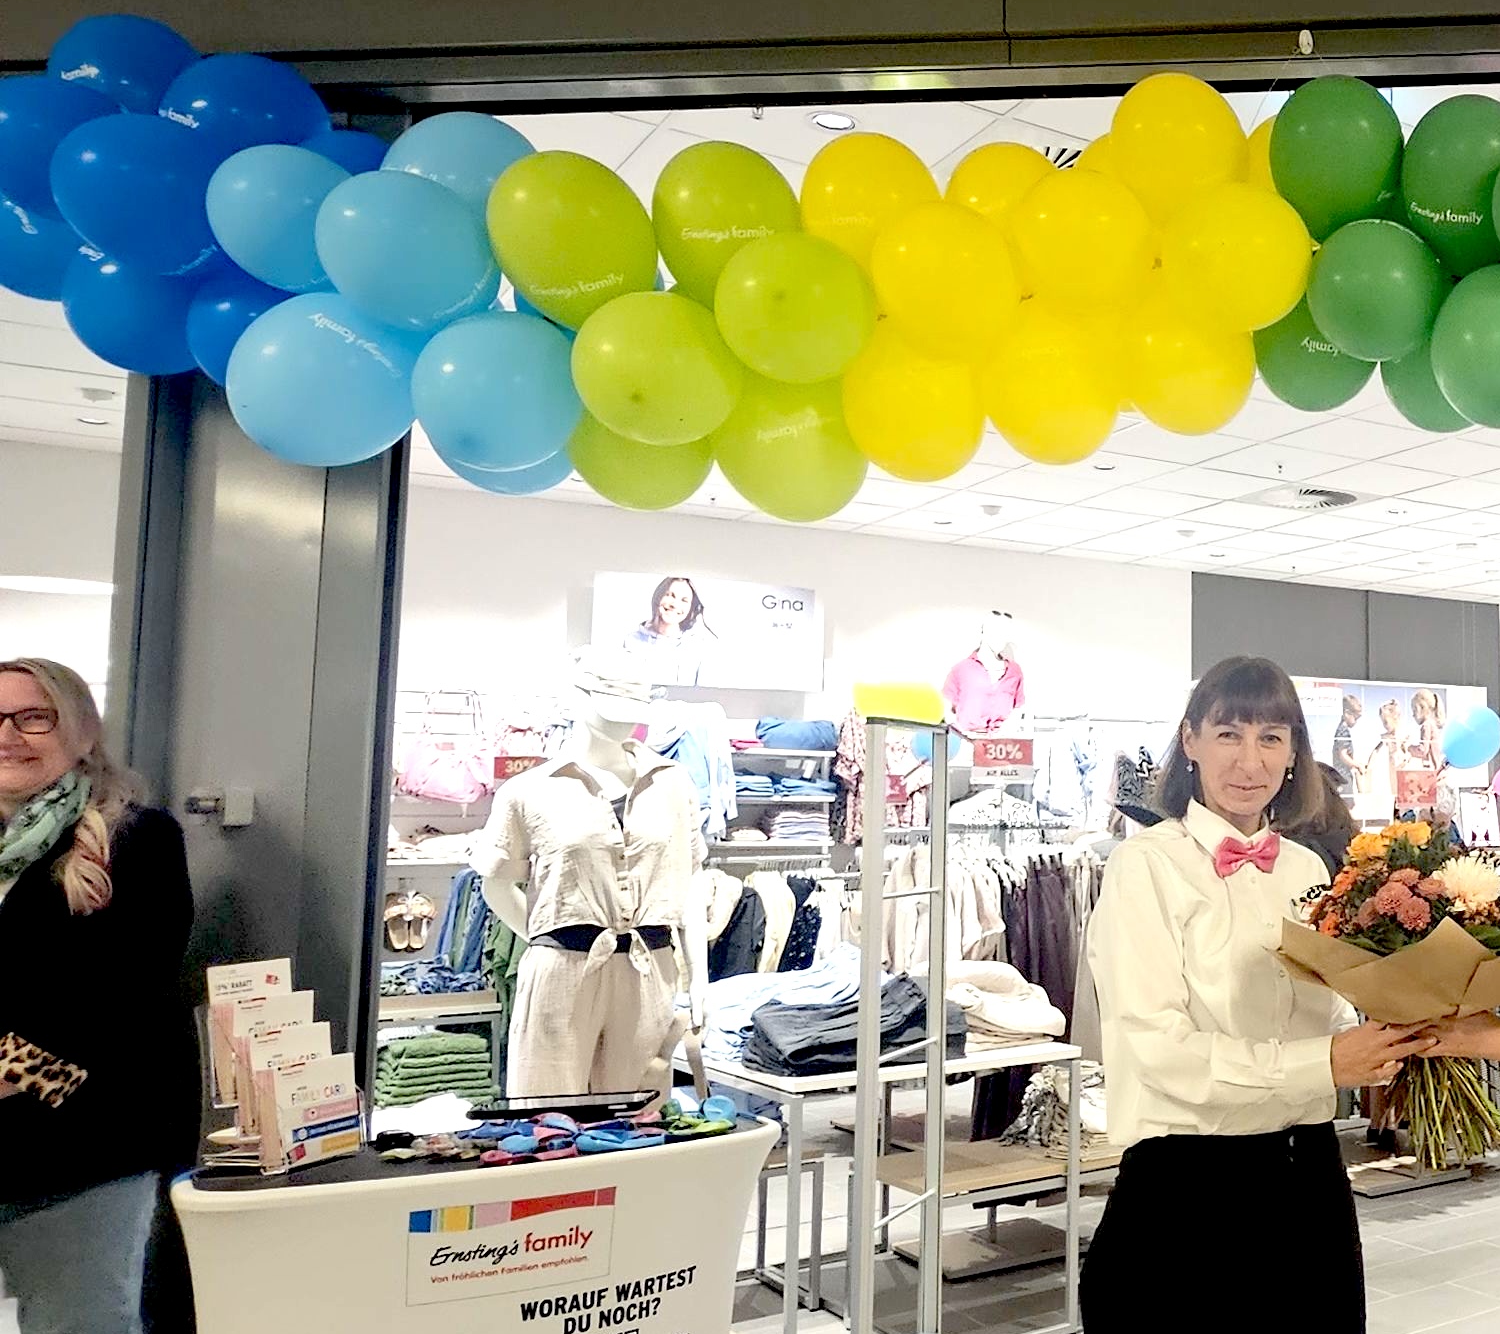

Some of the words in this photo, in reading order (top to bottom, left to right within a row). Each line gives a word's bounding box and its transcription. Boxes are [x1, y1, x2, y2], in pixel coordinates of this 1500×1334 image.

[1446, 209, 1484, 225] family
[578, 272, 624, 294] family
[985, 743, 1024, 761] 30%
[429, 1239, 520, 1268] Ernsting's
[523, 1225, 593, 1253] family
[430, 1275, 449, 1284] Von
[451, 1268, 499, 1282] fröhlichen
[500, 1263, 539, 1276] Familien
[520, 1287, 609, 1322] WORAUF
[615, 1265, 697, 1303] WARTEST
[598, 1297, 661, 1329] NOCH?
